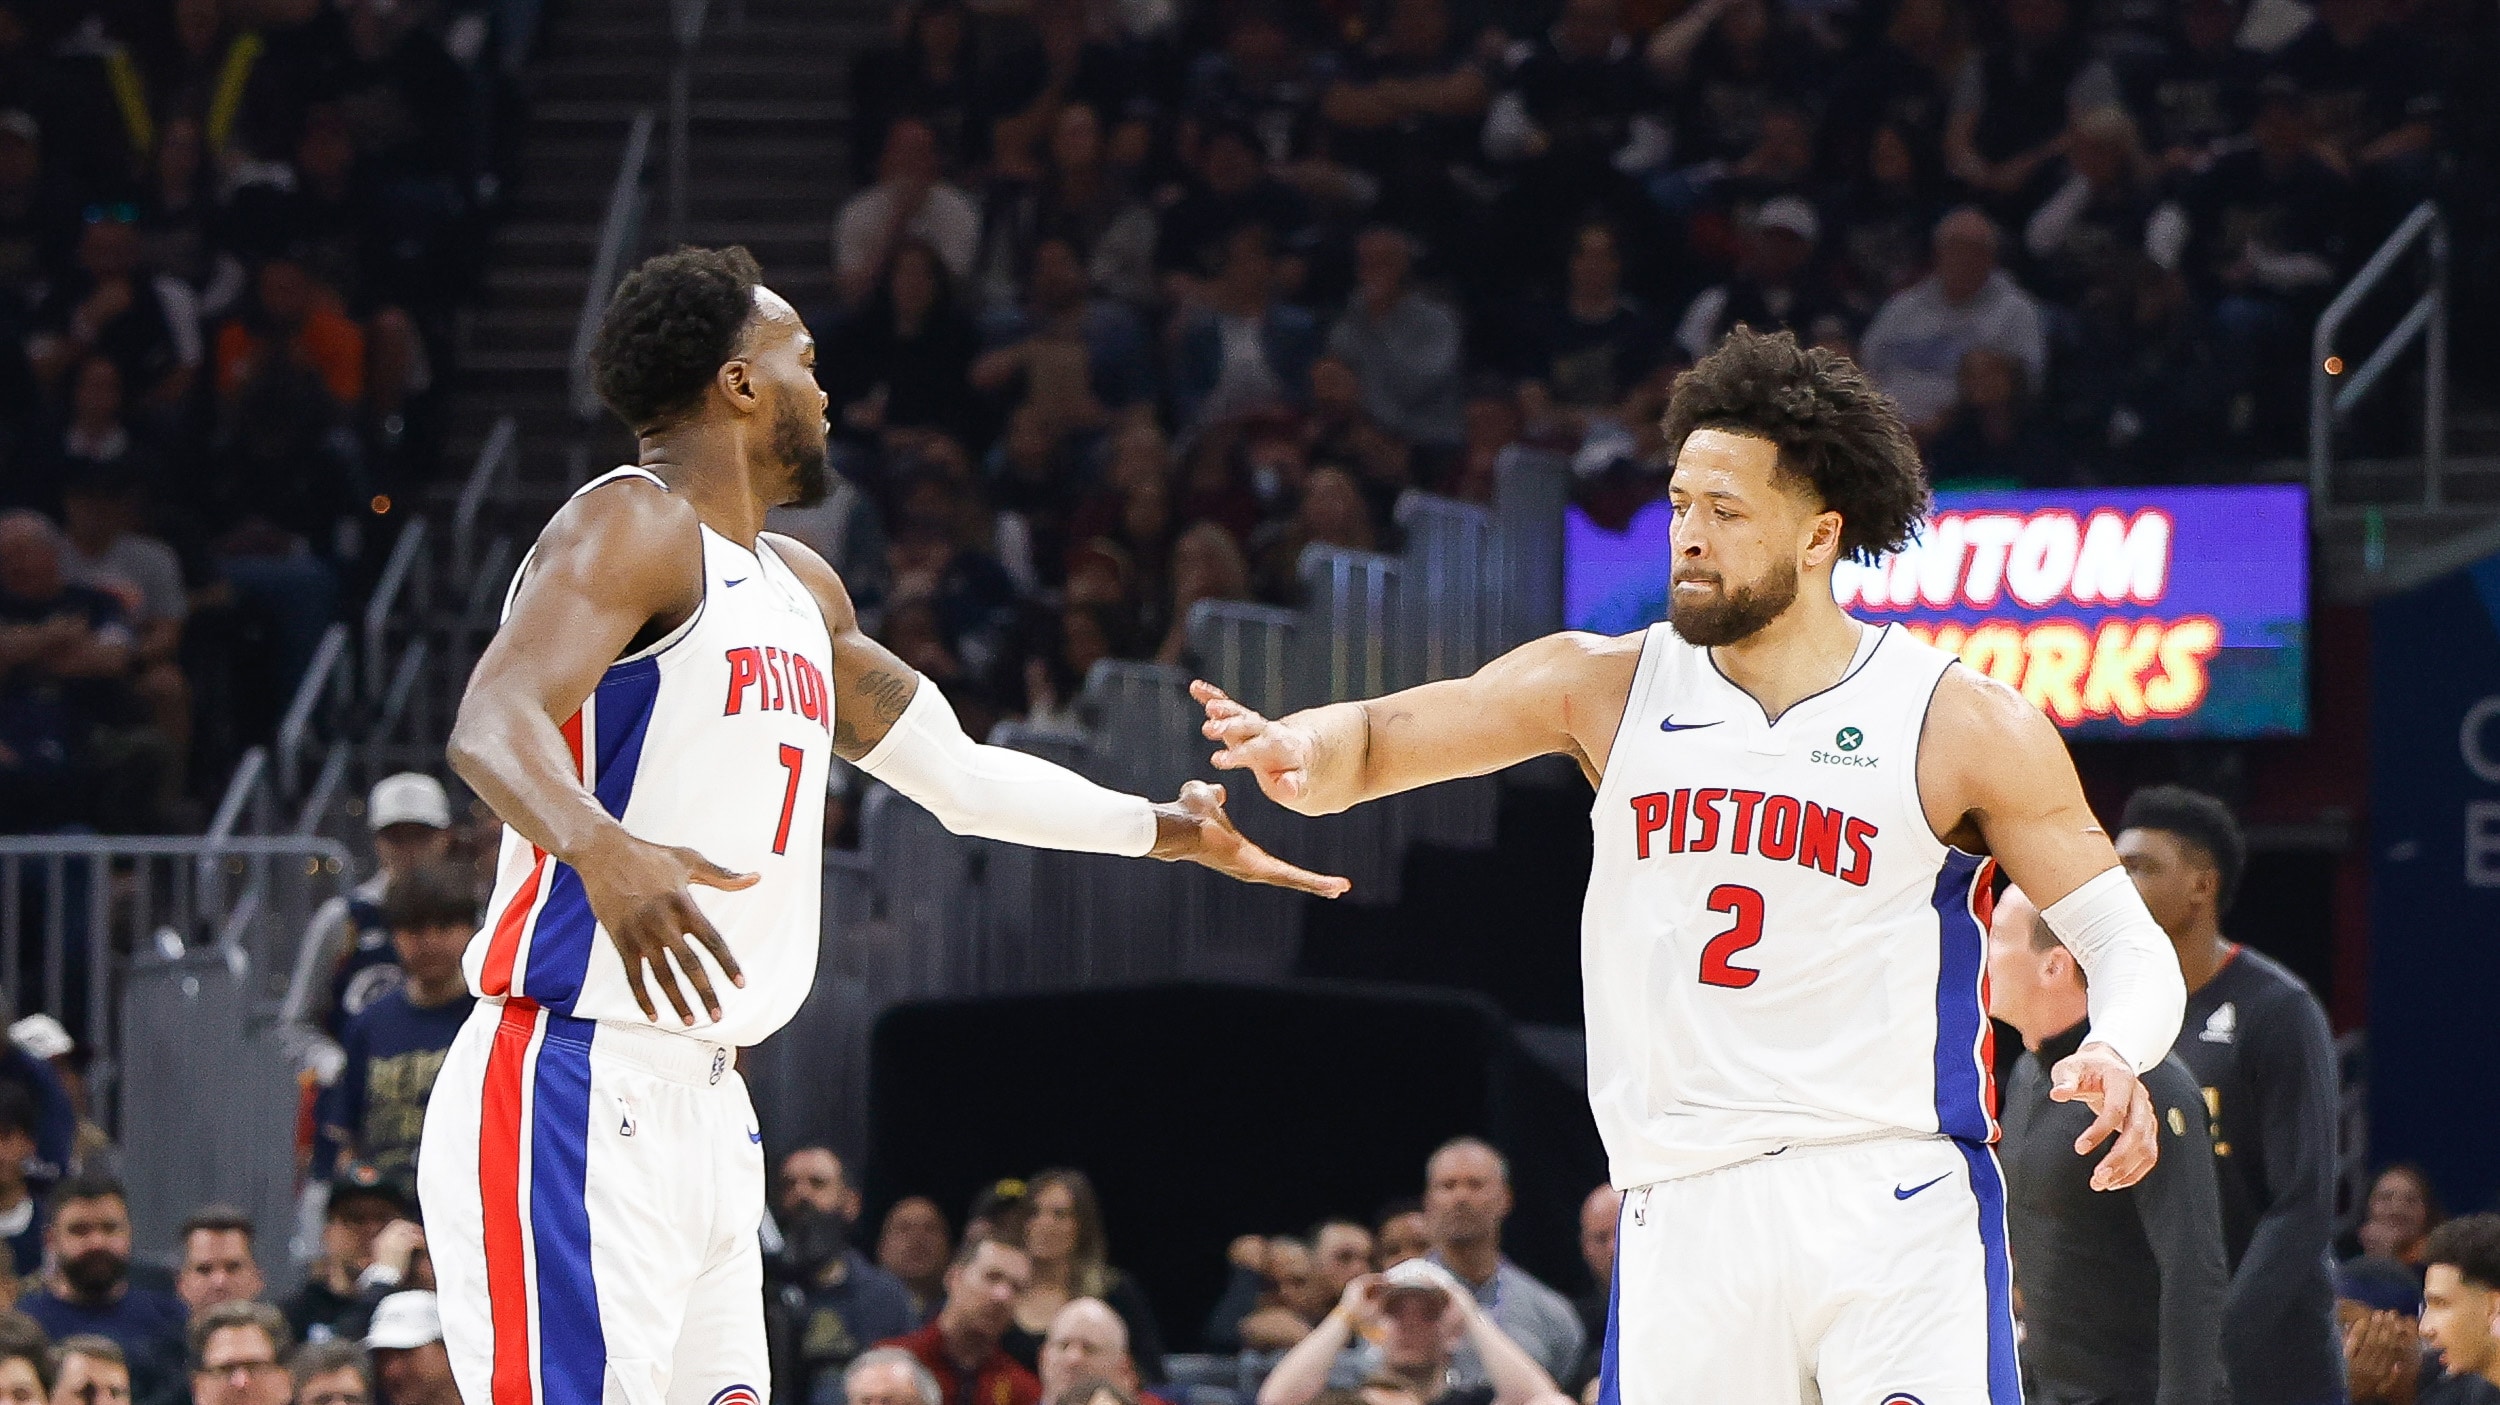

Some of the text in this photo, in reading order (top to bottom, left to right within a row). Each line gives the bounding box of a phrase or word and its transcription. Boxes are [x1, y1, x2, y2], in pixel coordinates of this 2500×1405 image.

[772, 743, 804, 856] 7
[1810, 750, 1879, 768] StockX
[1630, 788, 1878, 887] PISTONS
[1698, 884, 1764, 989] 2
